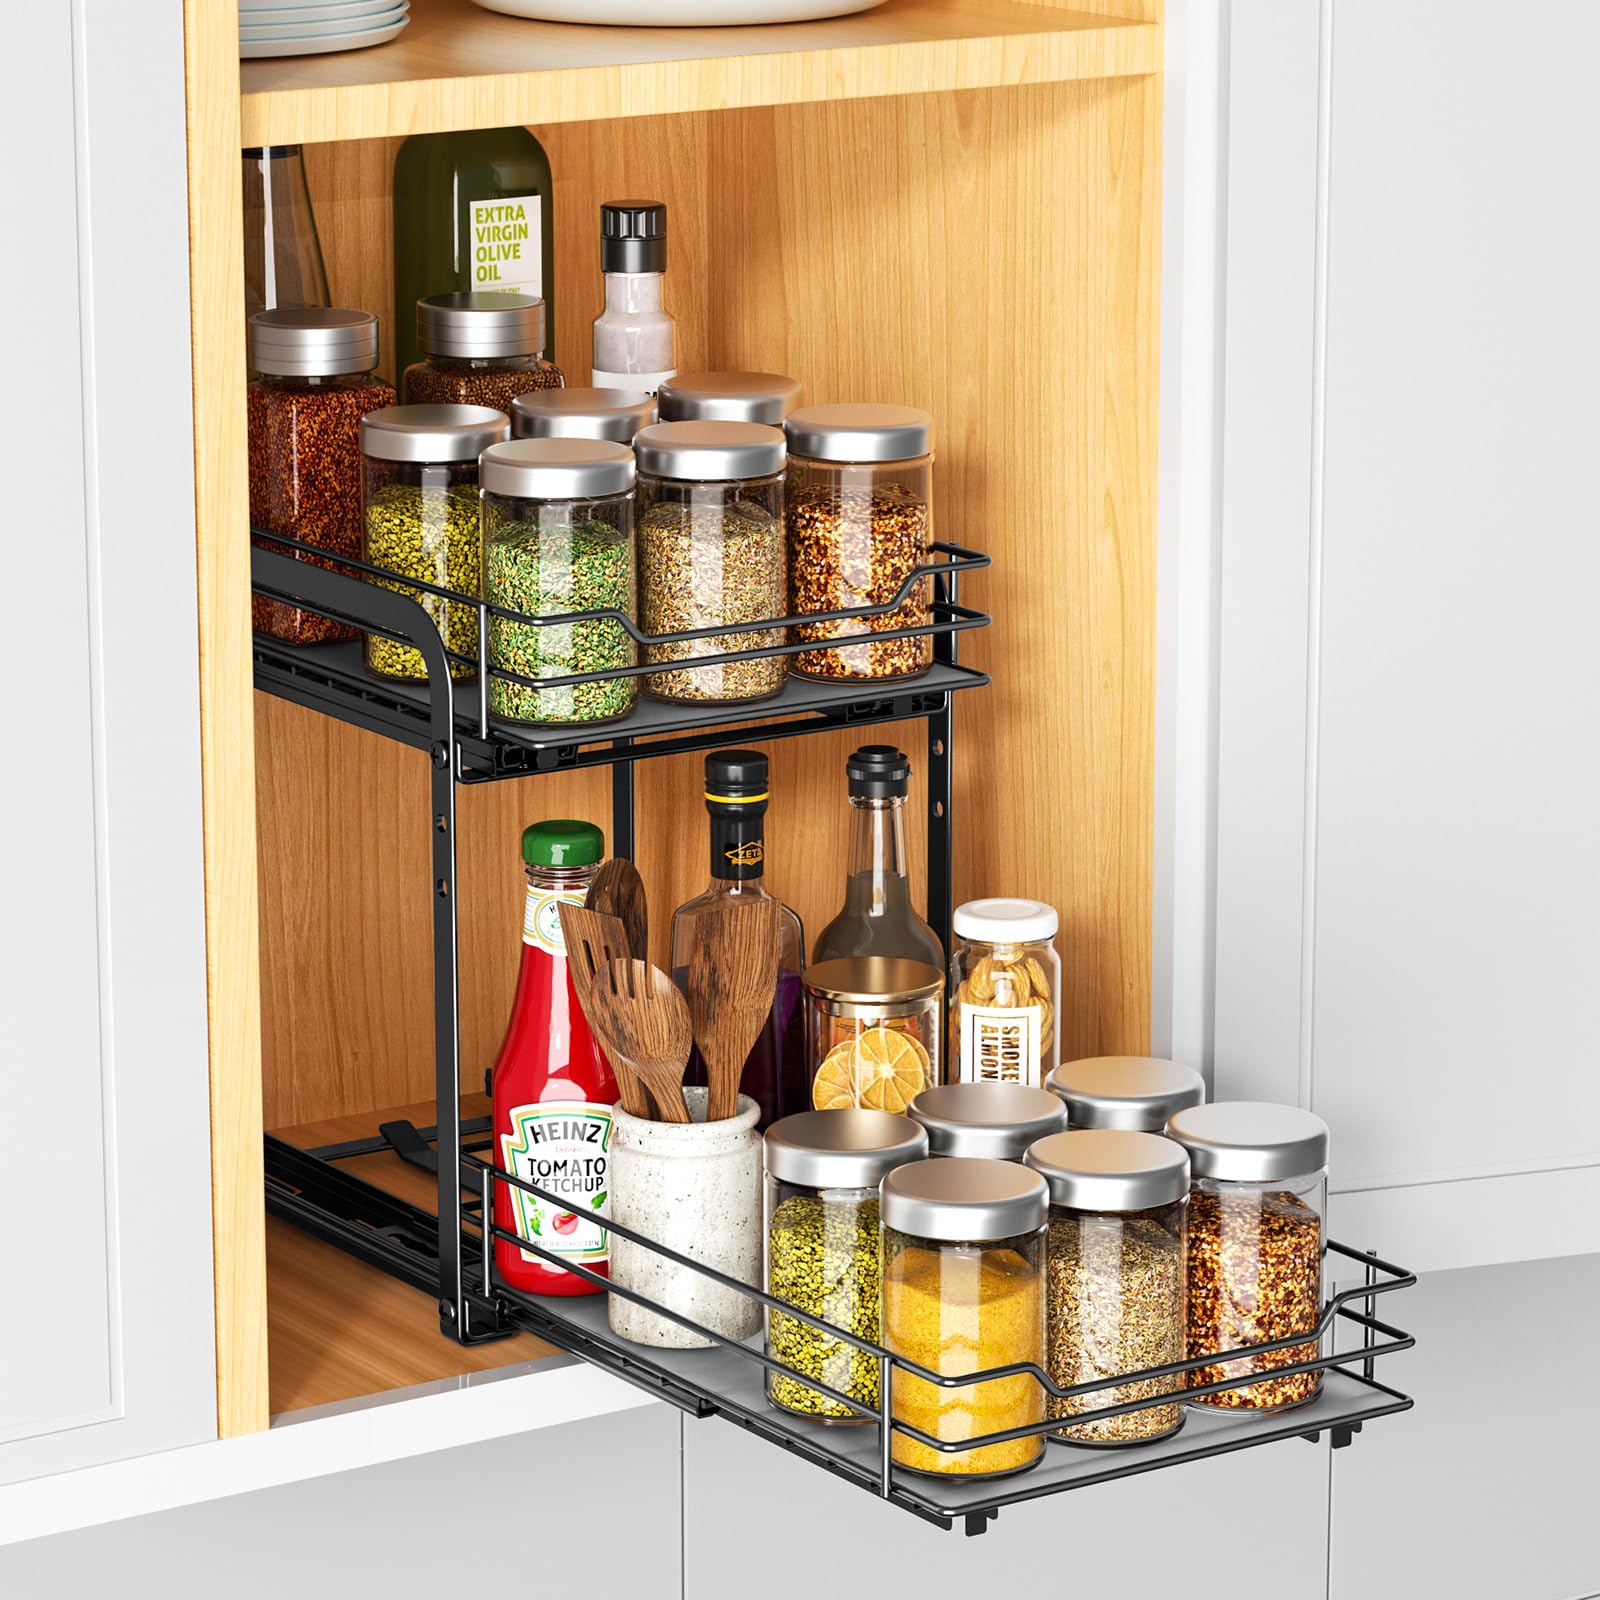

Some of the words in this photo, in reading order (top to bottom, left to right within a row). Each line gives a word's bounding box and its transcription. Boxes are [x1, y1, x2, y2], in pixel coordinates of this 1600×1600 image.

[475, 204, 526, 225] EXTRA
[475, 222, 529, 244] VIRGIN
[476, 243, 521, 263] OLIVE
[476, 264, 502, 282] OIL
[980, 1024, 999, 1083] ALMON
[1001, 1026, 1020, 1084] SMOKE
[529, 1121, 602, 1144] HEINZ
[527, 1157, 606, 1177] TOMATO
